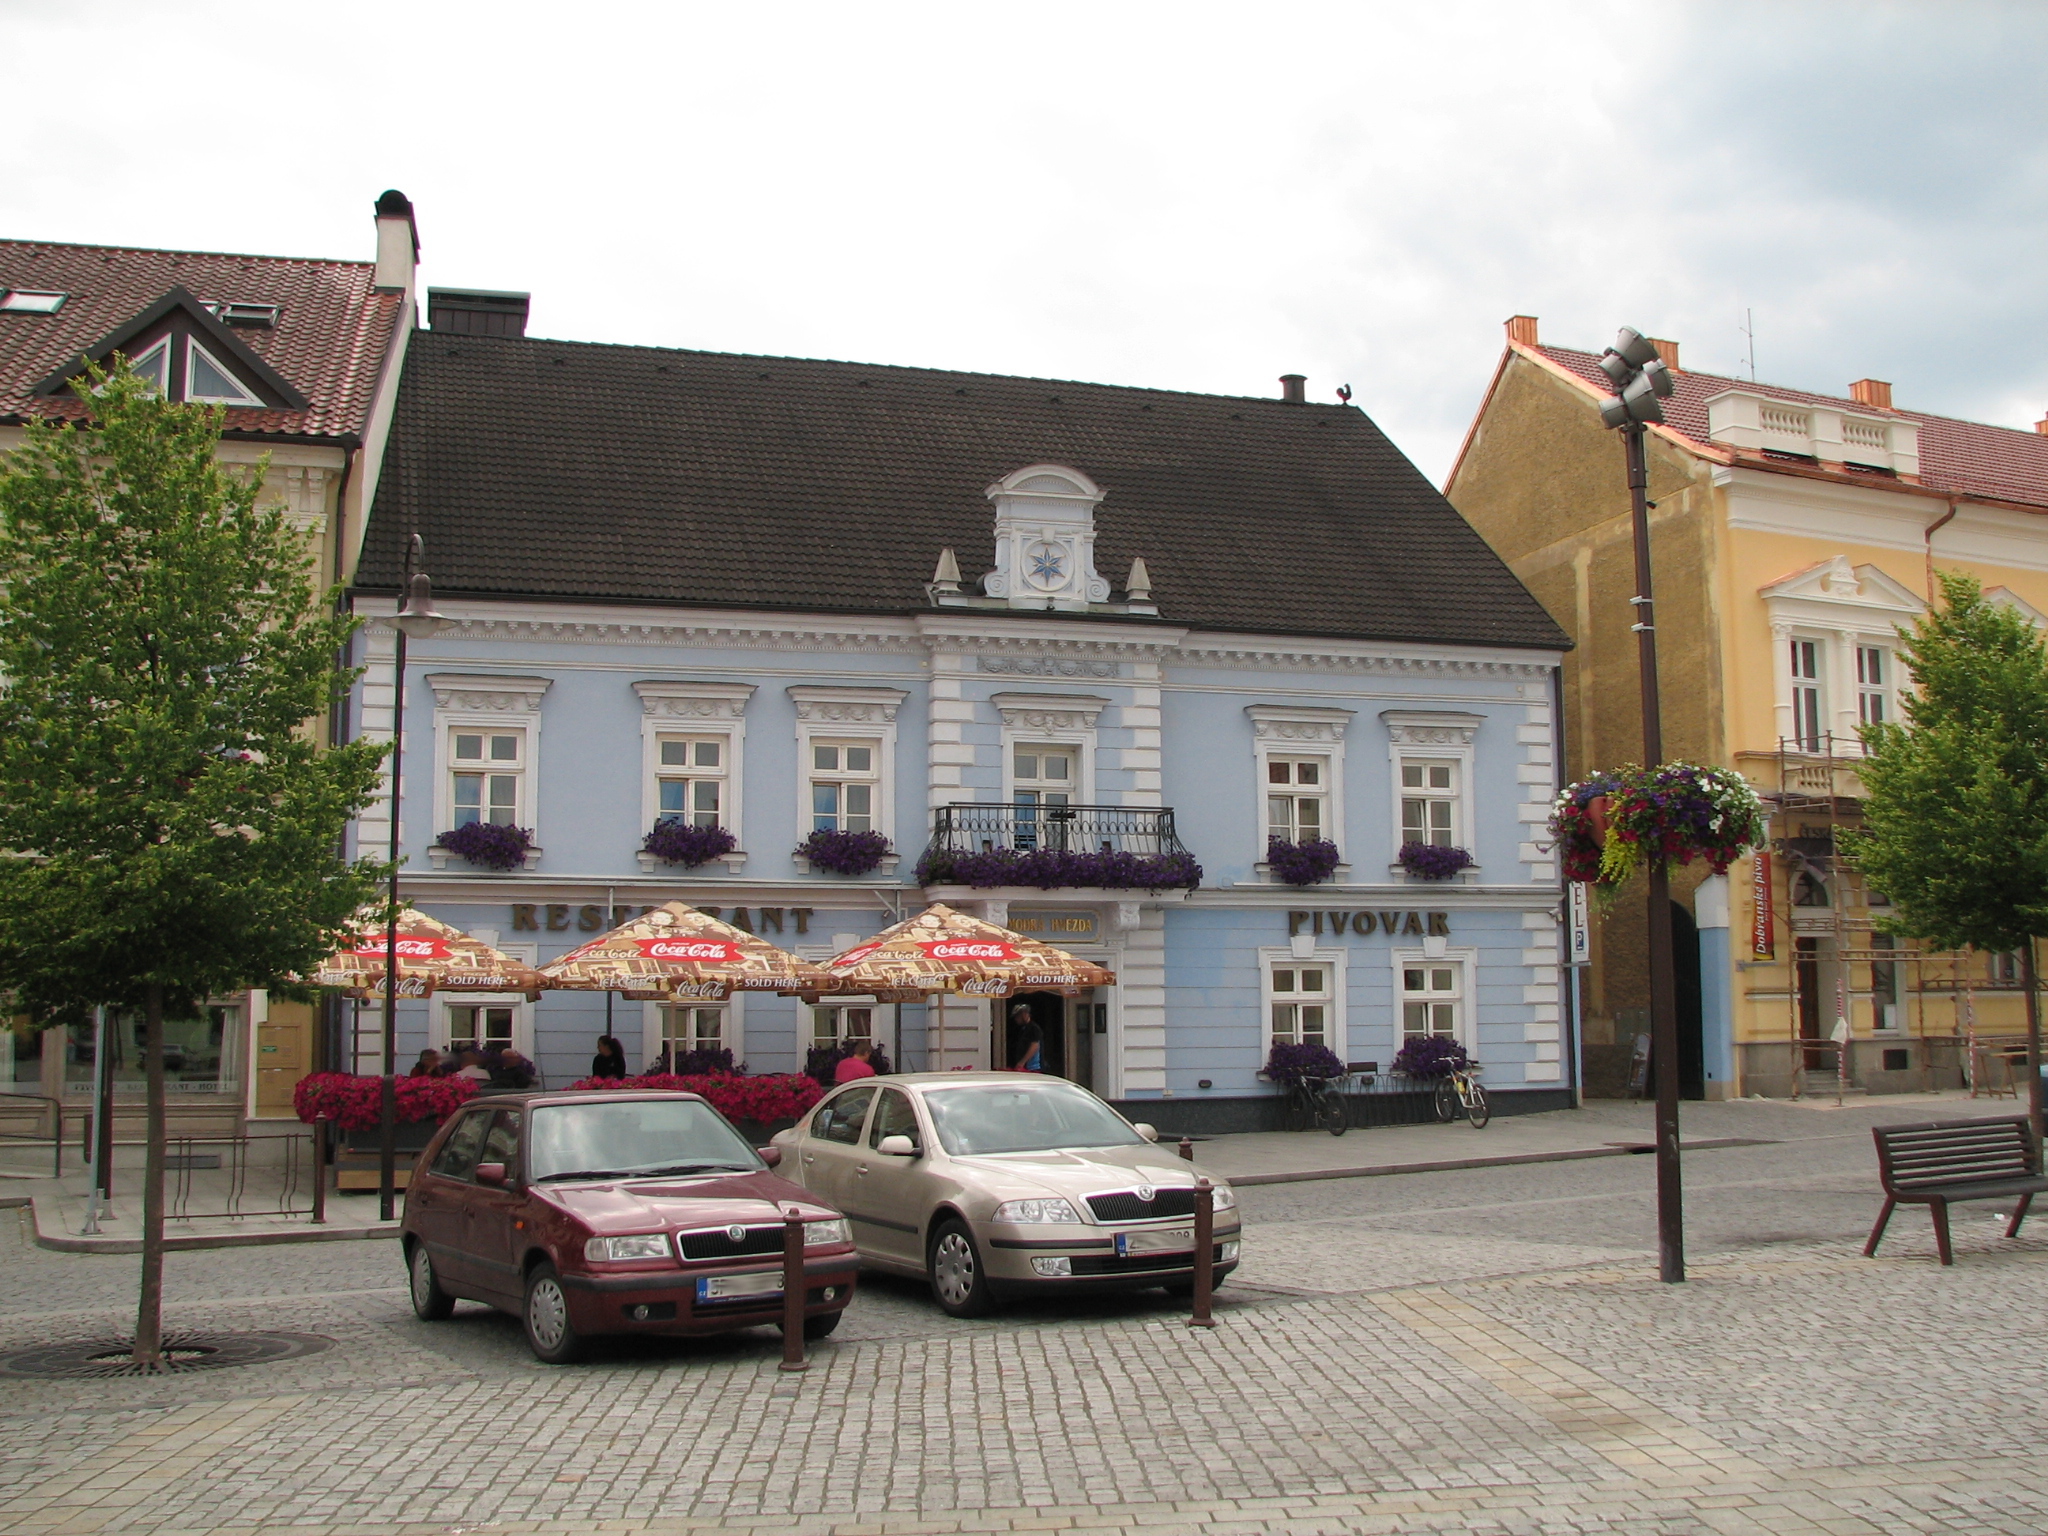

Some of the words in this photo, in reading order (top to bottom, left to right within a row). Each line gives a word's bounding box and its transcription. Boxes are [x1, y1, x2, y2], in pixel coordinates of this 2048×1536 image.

[1753, 857, 1765, 884] pivo
[512, 904, 814, 934] RESTANT
[1288, 911, 1451, 937] PIVOVAR
[651, 942, 727, 958] Coca-Cola
[933, 943, 1005, 958] Coca-Cola
[446, 975, 478, 985] SOLD
[478, 975, 505, 985] HERE
[744, 978, 773, 988] SOLD
[774, 978, 800, 988] HERE
[1026, 974, 1052, 984] SOLD
[1052, 974, 1077, 984] HERE
